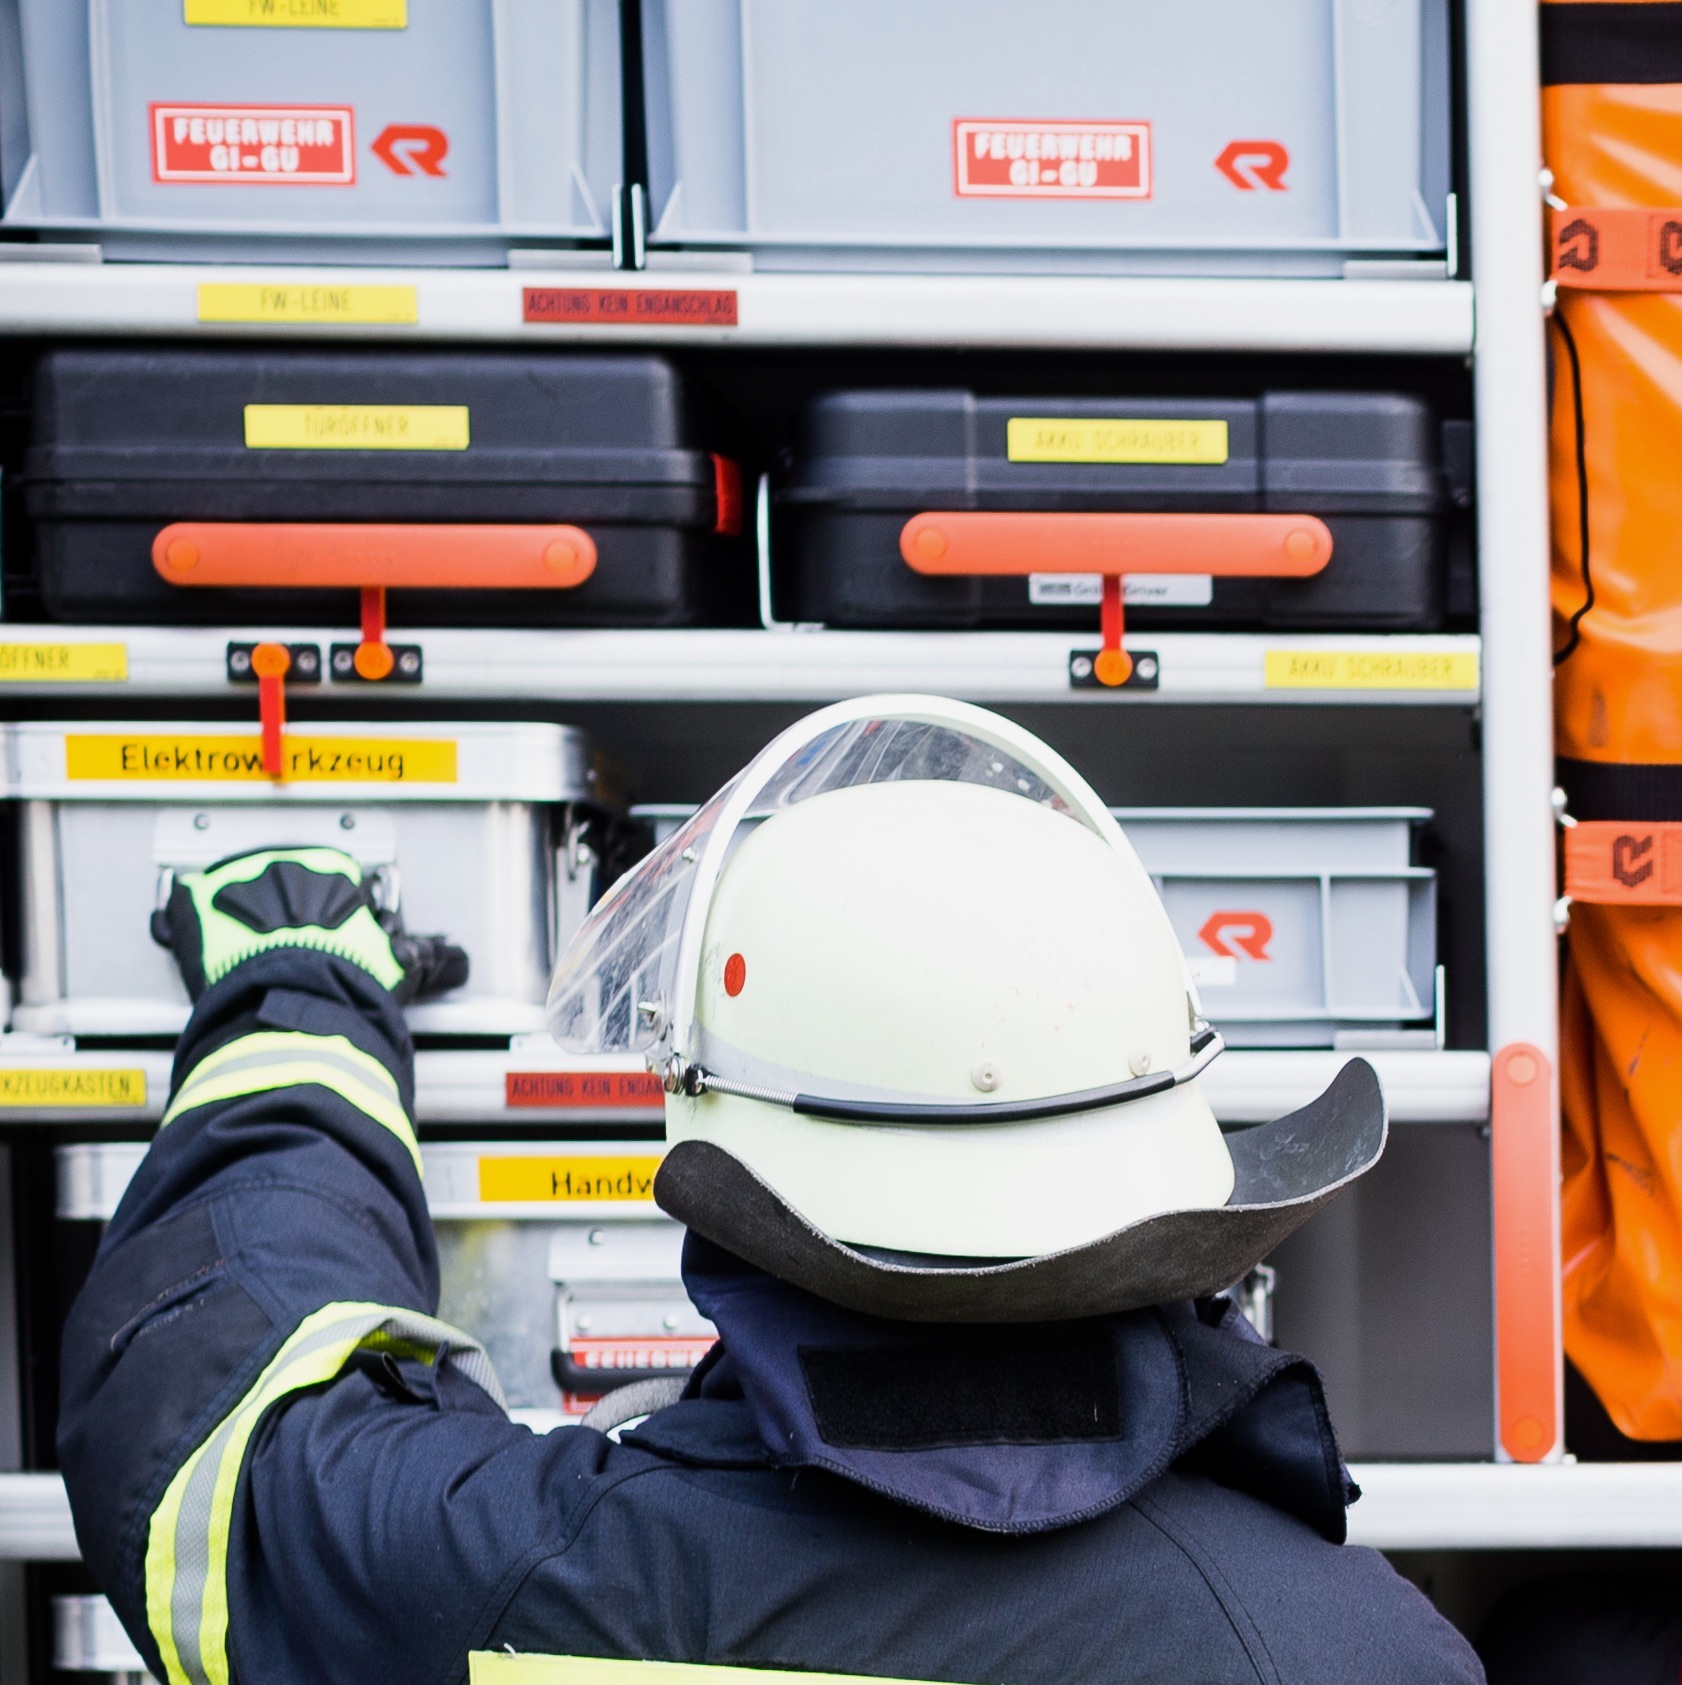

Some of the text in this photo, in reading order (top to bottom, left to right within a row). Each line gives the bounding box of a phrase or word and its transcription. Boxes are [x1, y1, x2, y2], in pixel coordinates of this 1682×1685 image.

[173, 117, 335, 147] FEUERWEHR
[974, 131, 1133, 161] FEUERWEHR
[209, 144, 299, 173] GI-GU
[1009, 158, 1098, 186] GI-GU
[260, 288, 353, 312] FW-LEINE
[121, 743, 405, 780] Elektrowrkzeug
